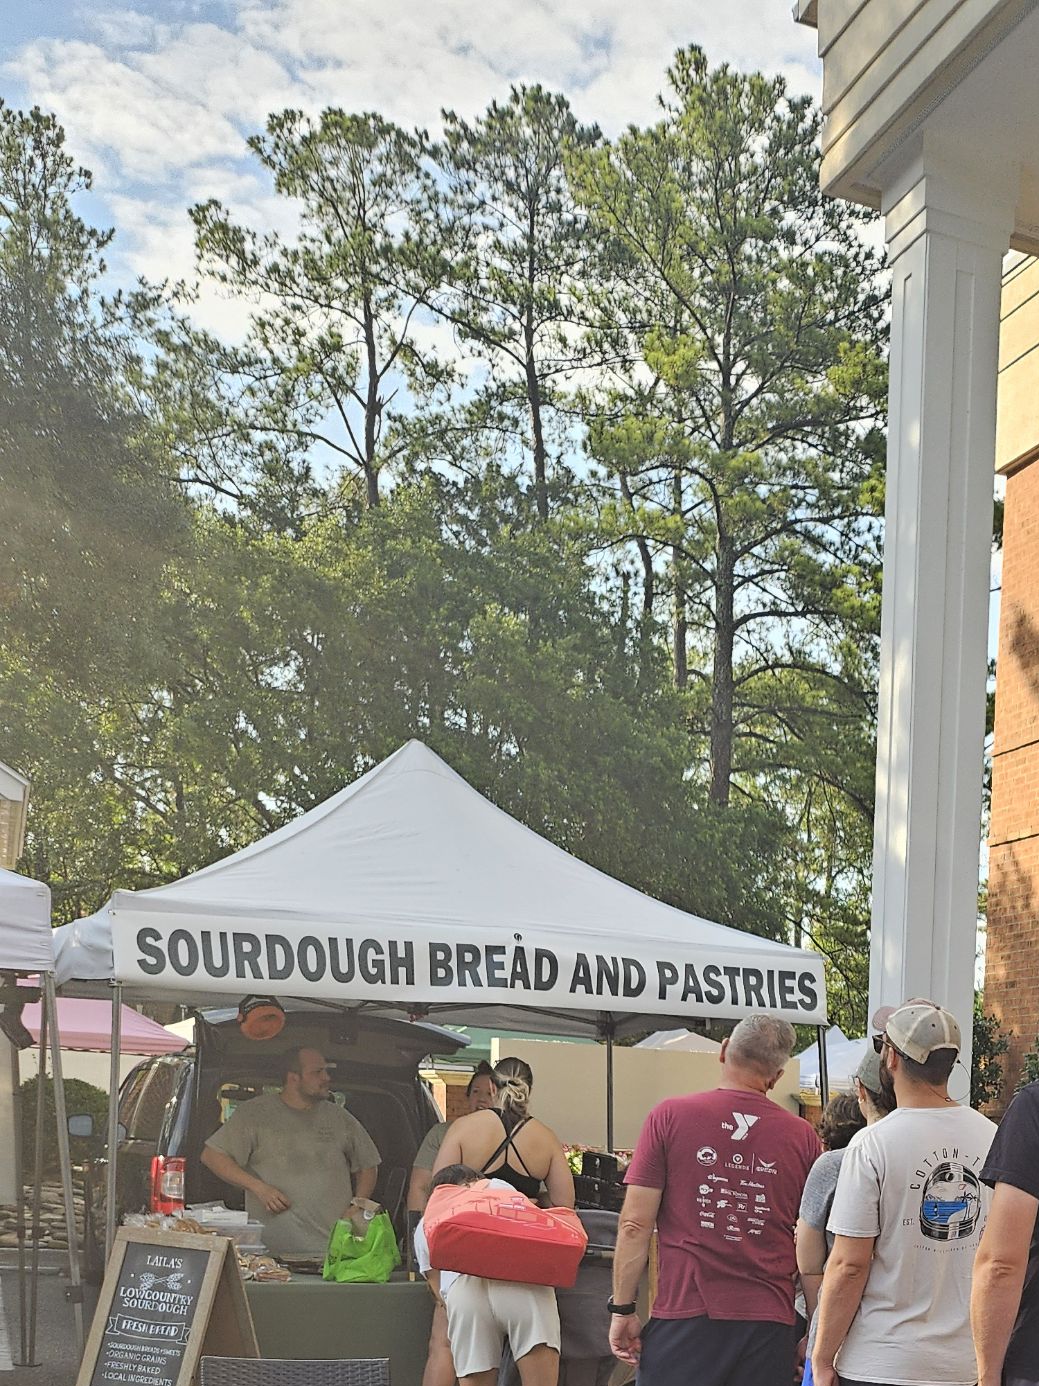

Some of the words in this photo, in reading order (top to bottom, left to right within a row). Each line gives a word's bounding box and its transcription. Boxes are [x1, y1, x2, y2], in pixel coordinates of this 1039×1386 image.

[136, 927, 415, 985] SOURDOUGH
[429, 942, 559, 991] BREAD
[569, 953, 646, 997] AND
[656, 961, 818, 1011] PASTRIES
[903, 1218, 915, 1226] EST.
[146, 1255, 183, 1269] LAILA'S
[120, 1287, 194, 1305] LOWCOUNTRY
[122, 1297, 189, 1315] SOURDOUGH
[122, 1320, 148, 1333] FRESH
[149, 1324, 178, 1336] BREAD
[141, 1354, 167, 1365] GRAINS
[138, 1365, 161, 1374] BAKED
[128, 1374, 173, 1386] INGREDIENTS
